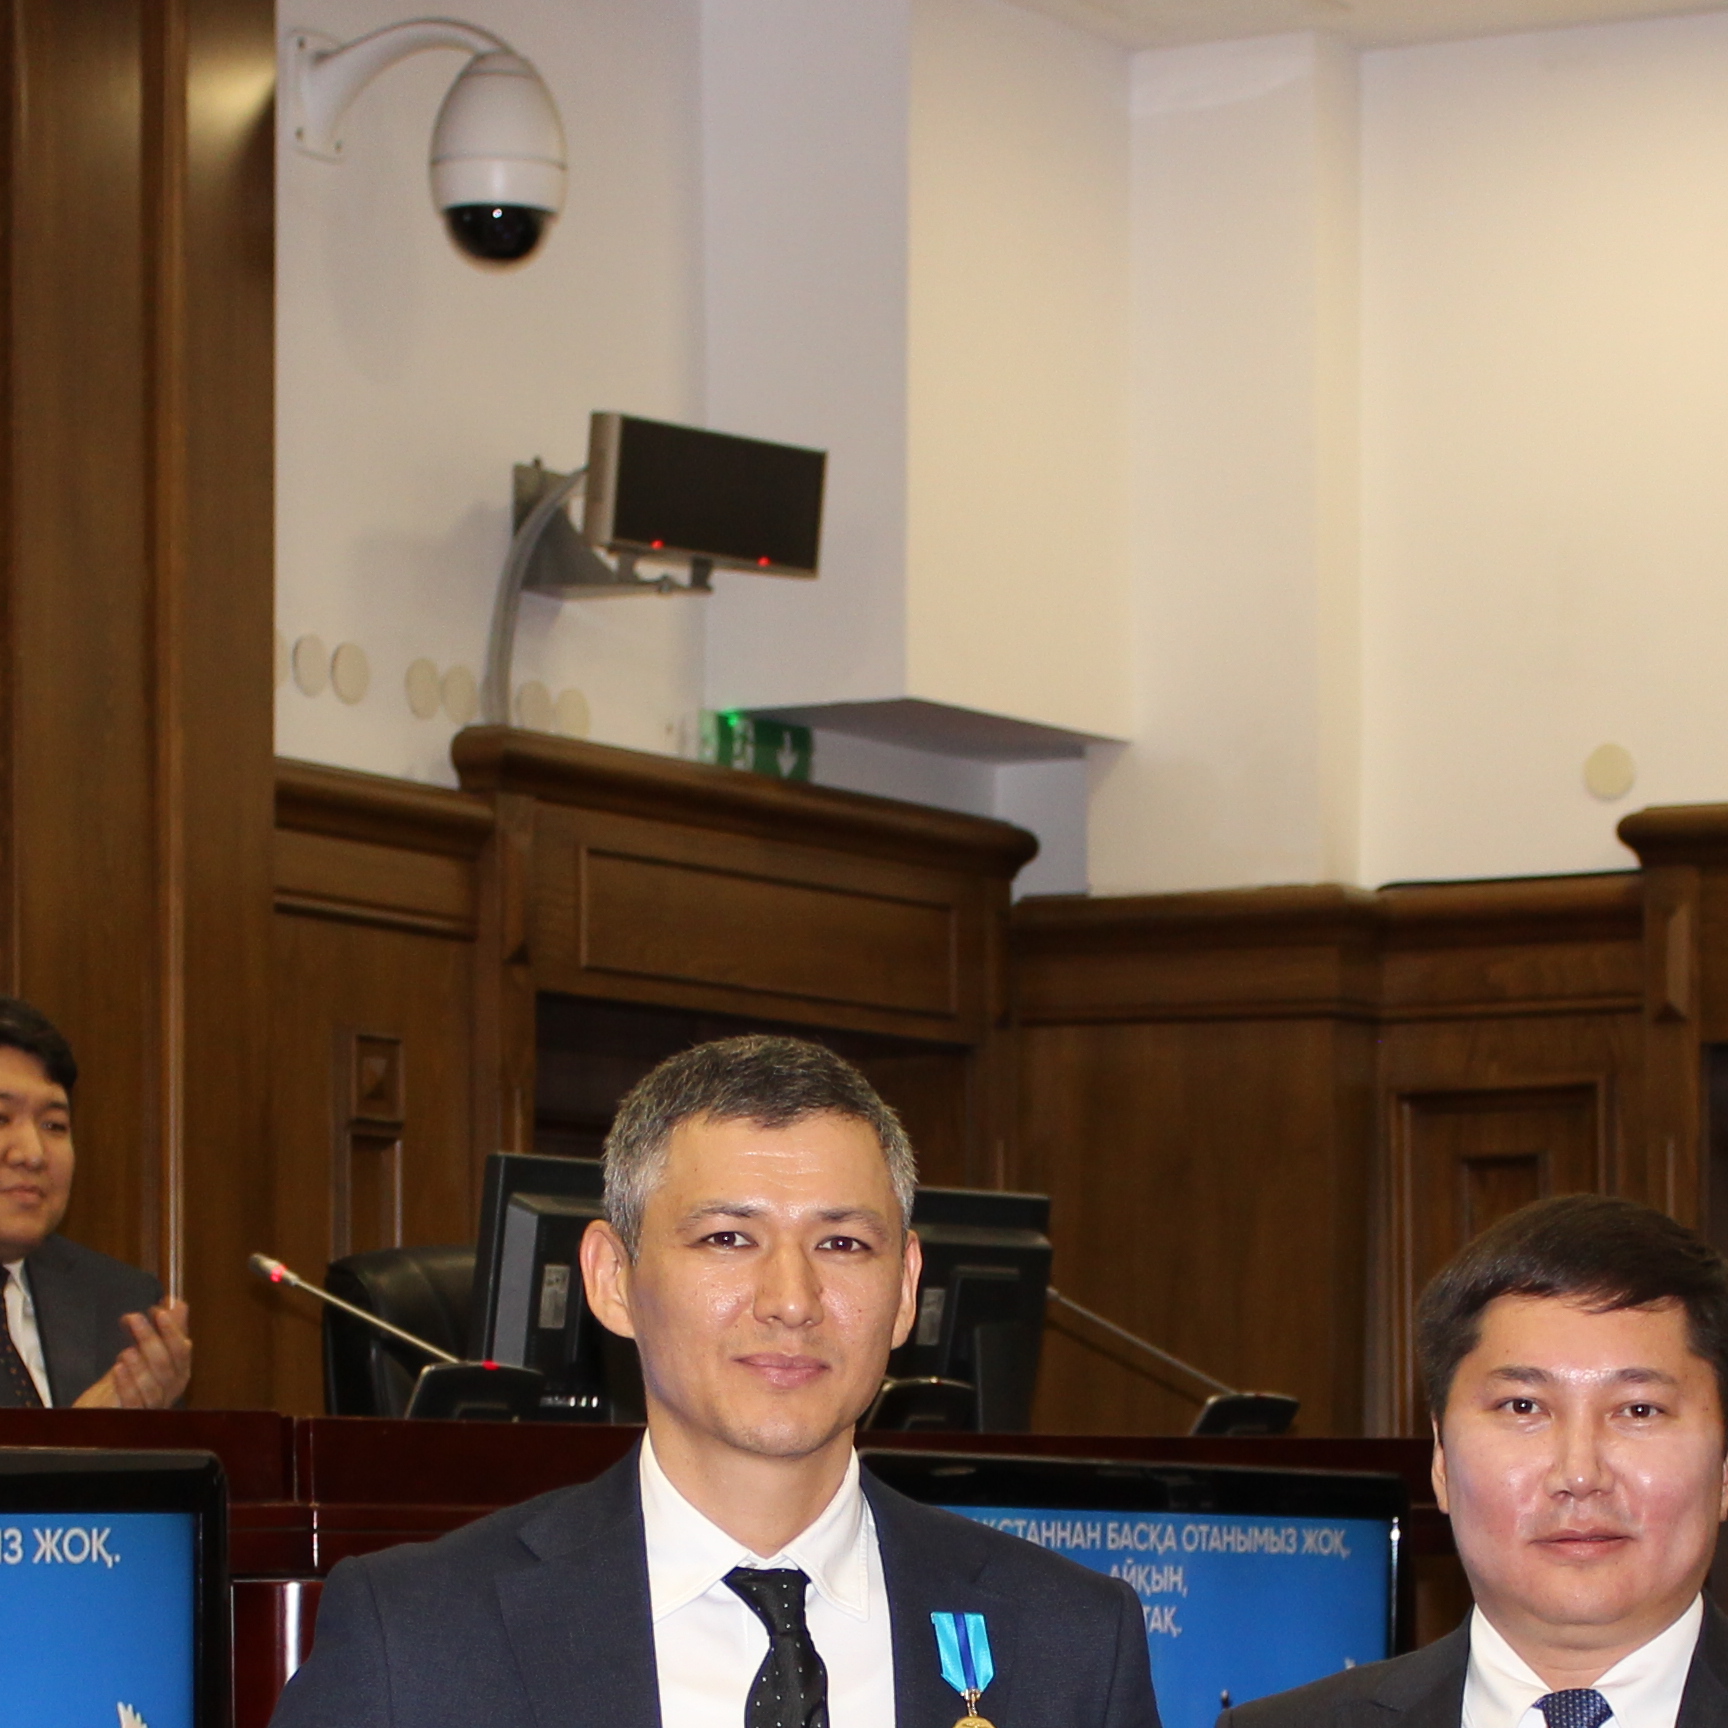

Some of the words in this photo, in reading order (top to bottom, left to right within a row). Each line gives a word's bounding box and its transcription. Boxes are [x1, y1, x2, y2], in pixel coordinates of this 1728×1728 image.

[33, 1527, 121, 1568] ЖОҚ.
[1106, 1522, 1177, 1555] БАСҚА
[1182, 1524, 1298, 1555] ОТАНЫМЫЗ
[1302, 1528, 1352, 1559] ЖОҚ.
